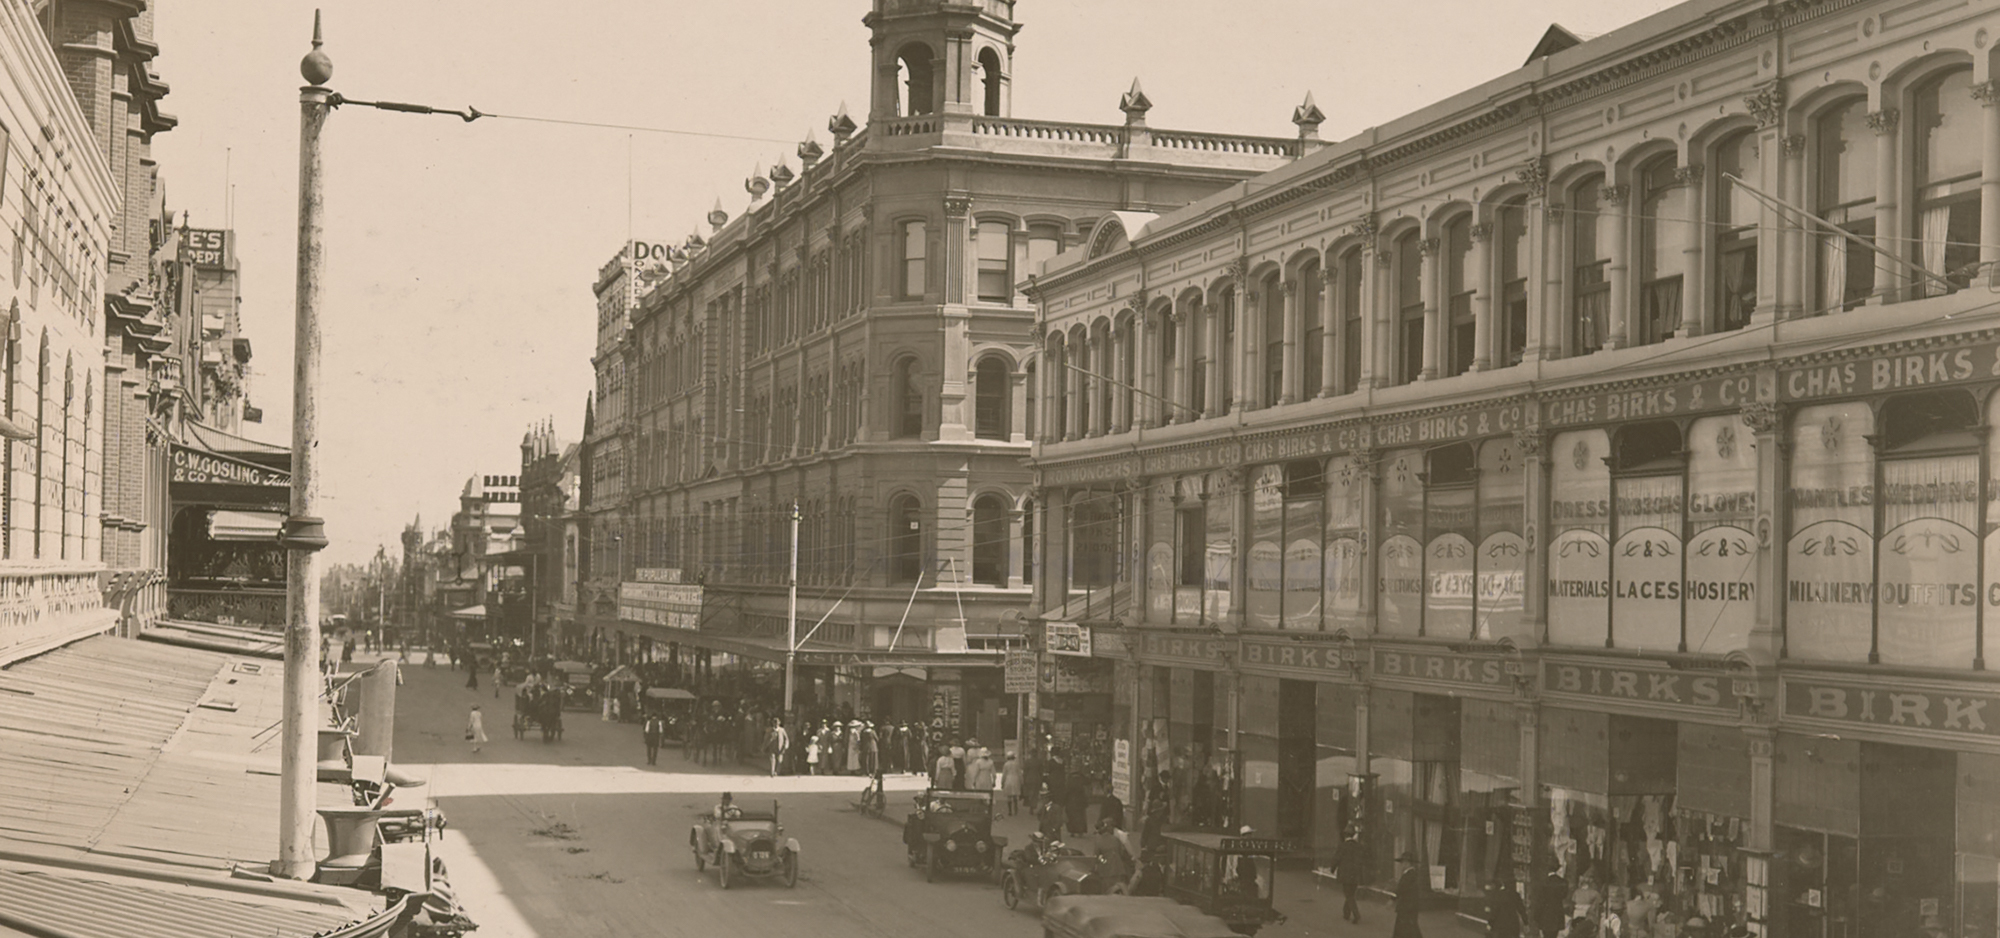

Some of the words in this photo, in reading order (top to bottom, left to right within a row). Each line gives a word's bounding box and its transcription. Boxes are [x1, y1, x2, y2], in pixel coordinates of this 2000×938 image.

[1872, 348, 1974, 391] BIRKS
[1607, 387, 1677, 420] BIRKS
[1689, 384, 1705, 410] &
[1418, 414, 1469, 441] BIRKS
[1476, 411, 1490, 435] &
[1278, 434, 1317, 458] BIRKS
[1321, 433, 1331, 452] &
[173, 467, 184, 482] &
[262, 473, 292, 488] Tail
[1045, 461, 1131, 486] IRONMONGERS
[1170, 450, 1200, 470] BIRKS
[1205, 450, 1213, 465] &
[1884, 479, 1976, 505] WEDDING
[1552, 499, 1609, 520] DRESS
[1643, 539, 1654, 558] &
[1718, 538, 1729, 558] &
[1824, 534, 1837, 556] &
[1549, 578, 1609, 599] MATERIALS
[1616, 581, 1680, 600] LACES
[1790, 580, 1873, 605] MILLINERY
[1881, 583, 1976, 607] OUTFITS
[1146, 634, 1217, 660] BIRKS
[1247, 644, 1341, 669] BIRKS
[1383, 653, 1500, 684] BIRKS
[1557, 666, 1721, 706] BIRKS
[1808, 686, 1987, 731] BIRK
